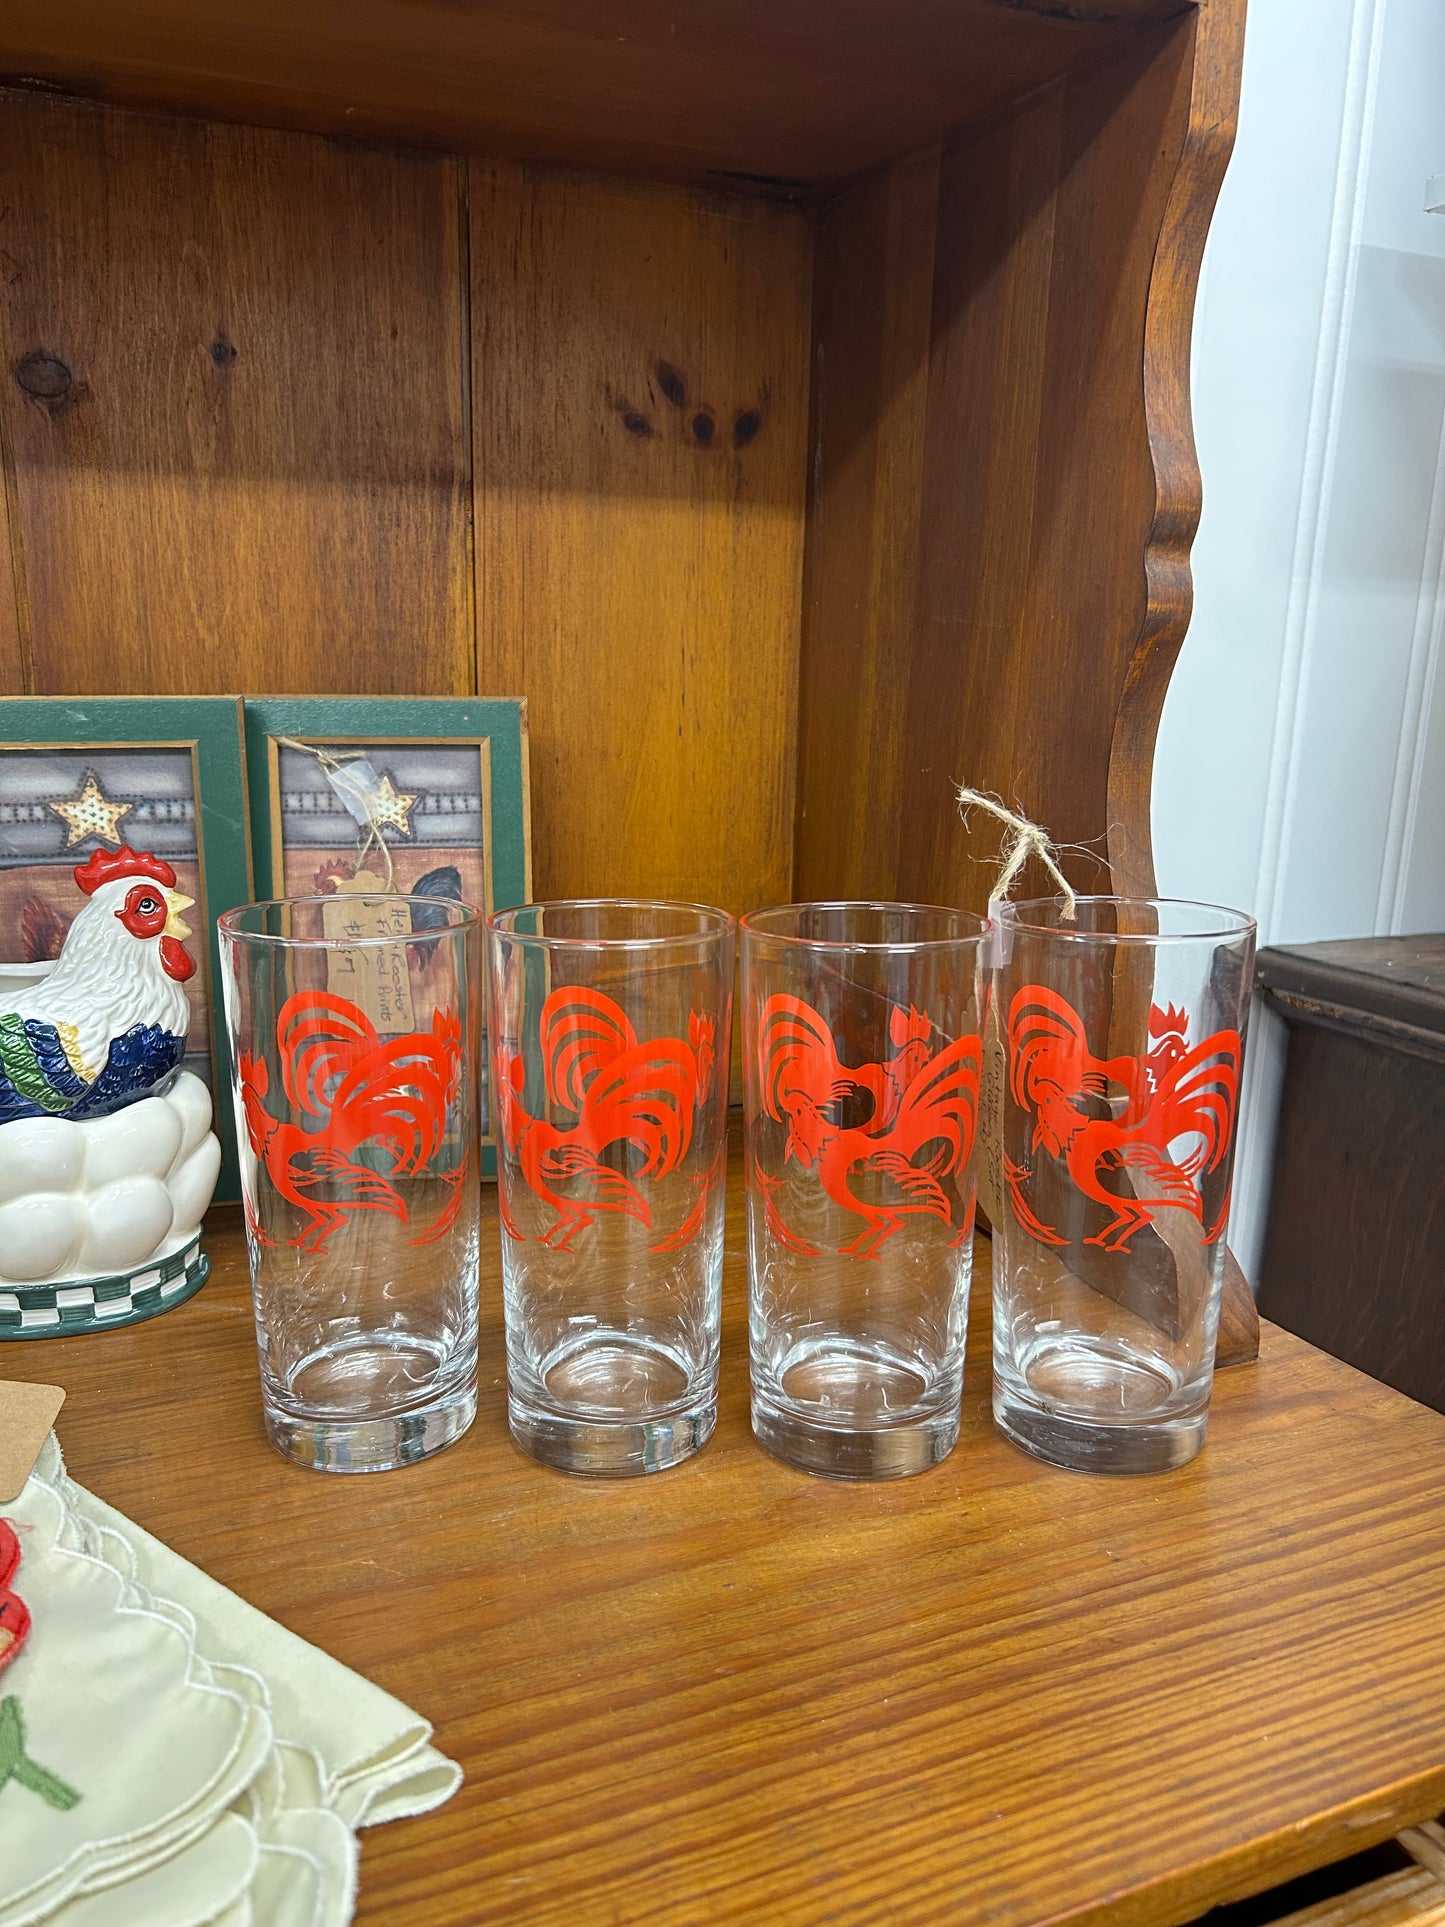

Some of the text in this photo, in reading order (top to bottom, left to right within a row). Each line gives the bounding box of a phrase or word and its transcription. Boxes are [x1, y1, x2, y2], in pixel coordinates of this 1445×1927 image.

[376, 919, 394, 1022] Frmed Prints
[391, 954, 407, 1020] Rooster
